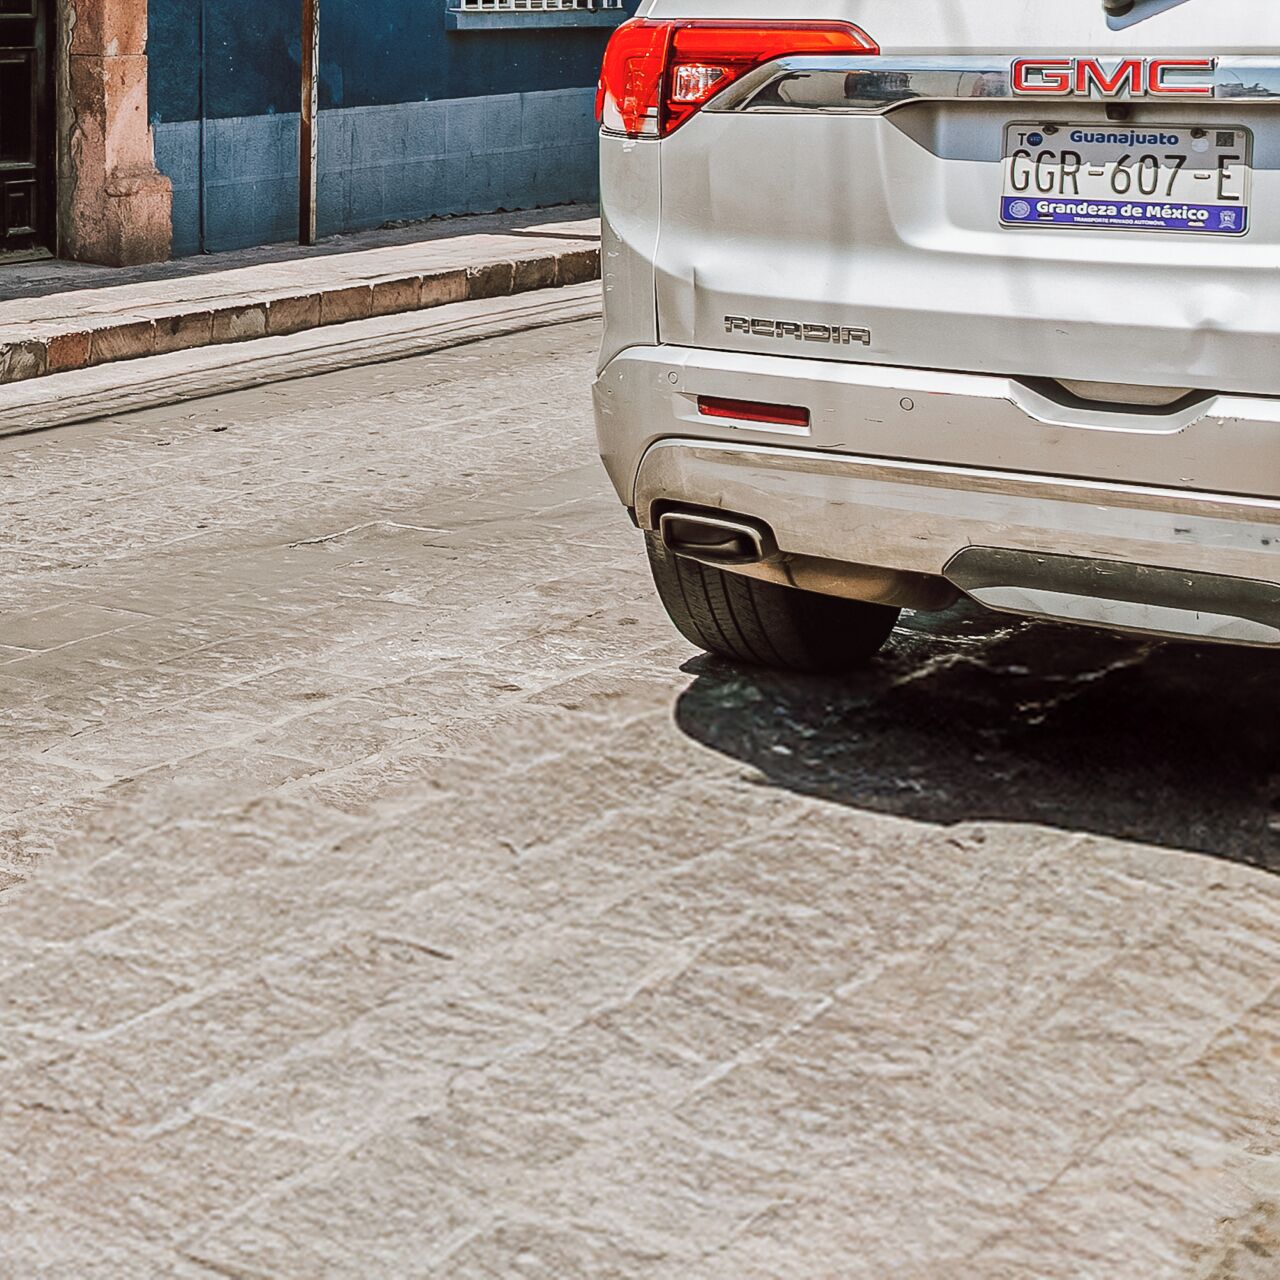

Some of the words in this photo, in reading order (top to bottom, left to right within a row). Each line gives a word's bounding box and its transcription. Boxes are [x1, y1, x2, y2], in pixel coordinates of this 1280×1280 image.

[1010, 57, 1216, 98] GMC
[1070, 130, 1179, 147] Guanajuato
[1010, 148, 1240, 200] GGR-607-E
[1036, 201, 1117, 216] Grandeza
[1120, 204, 1143, 218] de
[1146, 205, 1209, 221] México
[1073, 216, 1109, 224] TRANSPORTE
[724, 315, 871, 346] ACADIA
